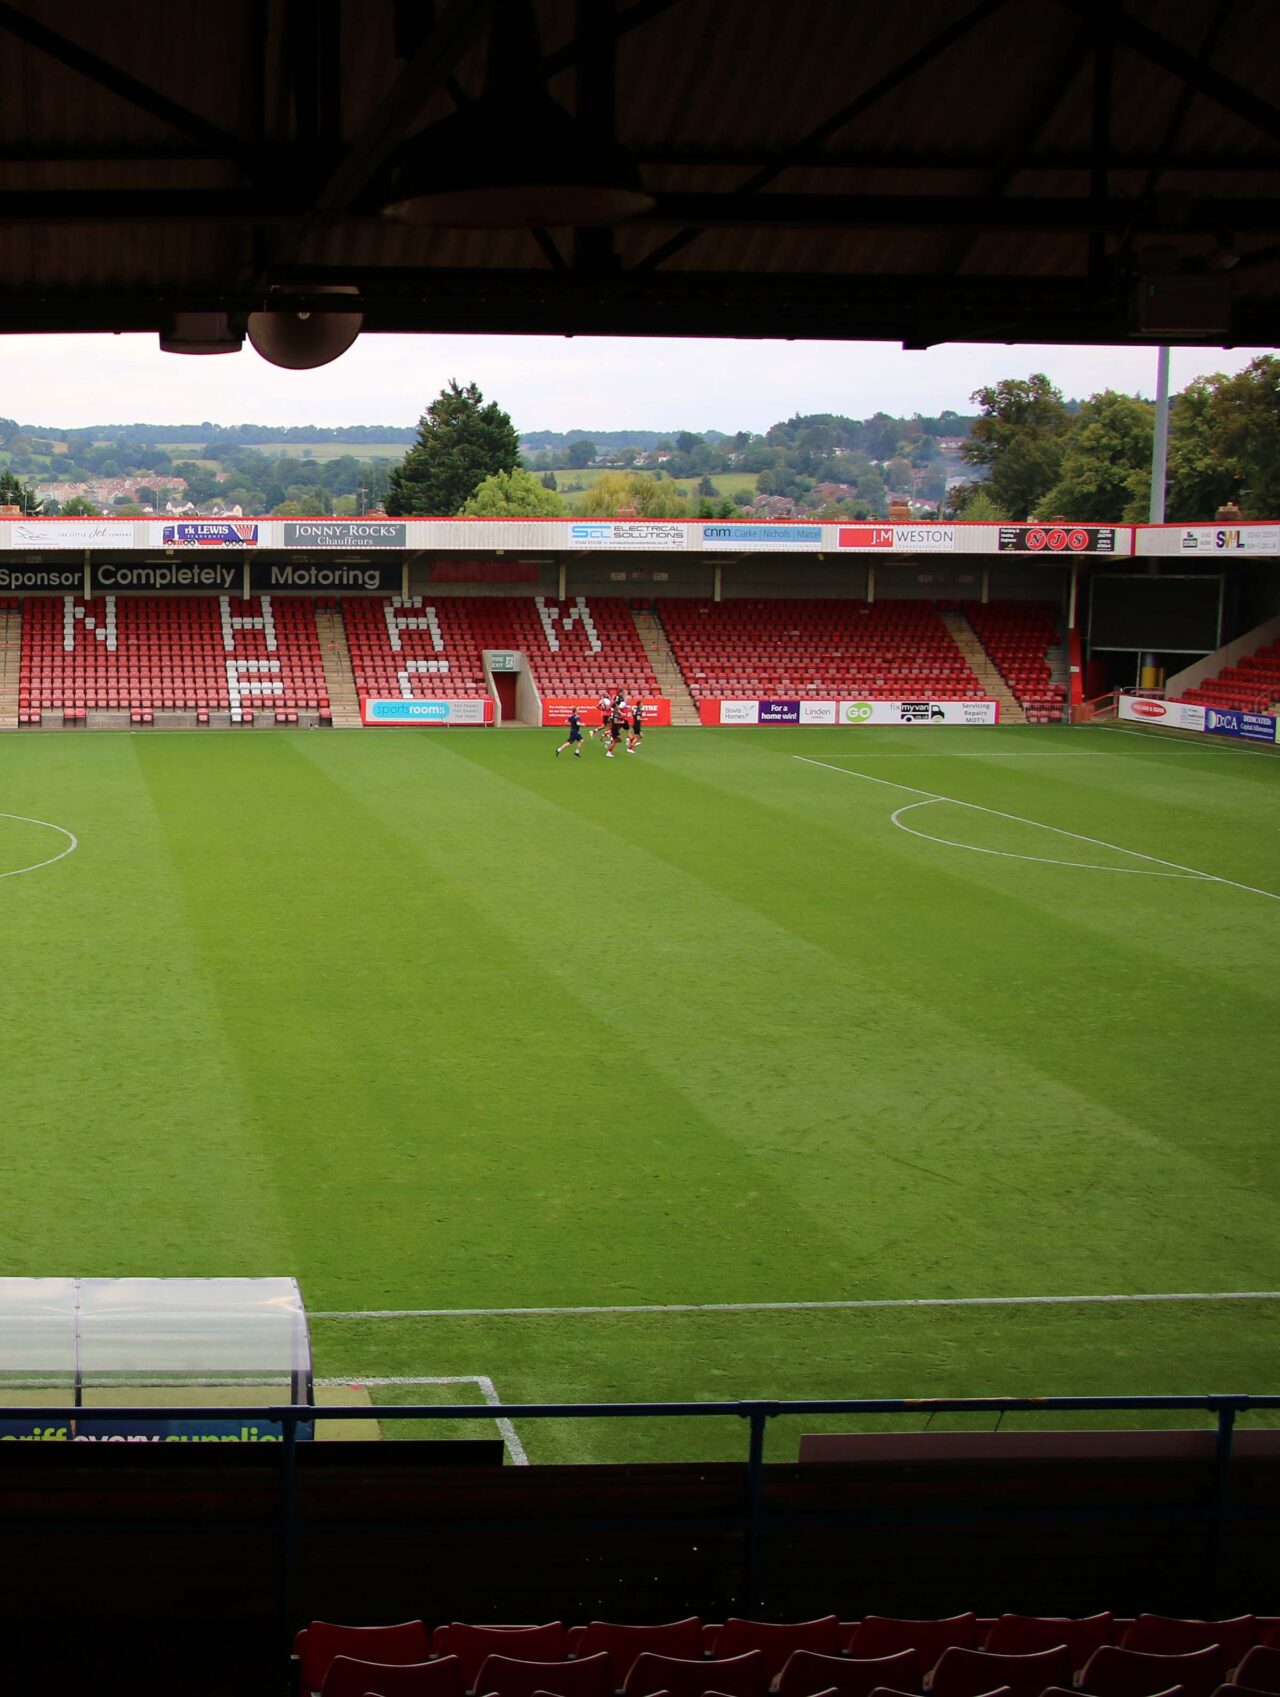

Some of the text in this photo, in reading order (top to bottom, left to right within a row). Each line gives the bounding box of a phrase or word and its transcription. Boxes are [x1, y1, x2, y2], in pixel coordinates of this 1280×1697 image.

[185, 526, 229, 535] rk LEWIS
[295, 525, 397, 537] JONNY-ROCKS
[704, 527, 820, 538] cnm Clarke Nicholls Marcel
[317, 537, 373, 545] Chauffeurs
[871, 528, 954, 545] J.M WESTON
[97, 564, 235, 588] Completely
[271, 565, 380, 589] Motoring
[377, 704, 446, 715] sportsrooms
[847, 707, 870, 718] GO
